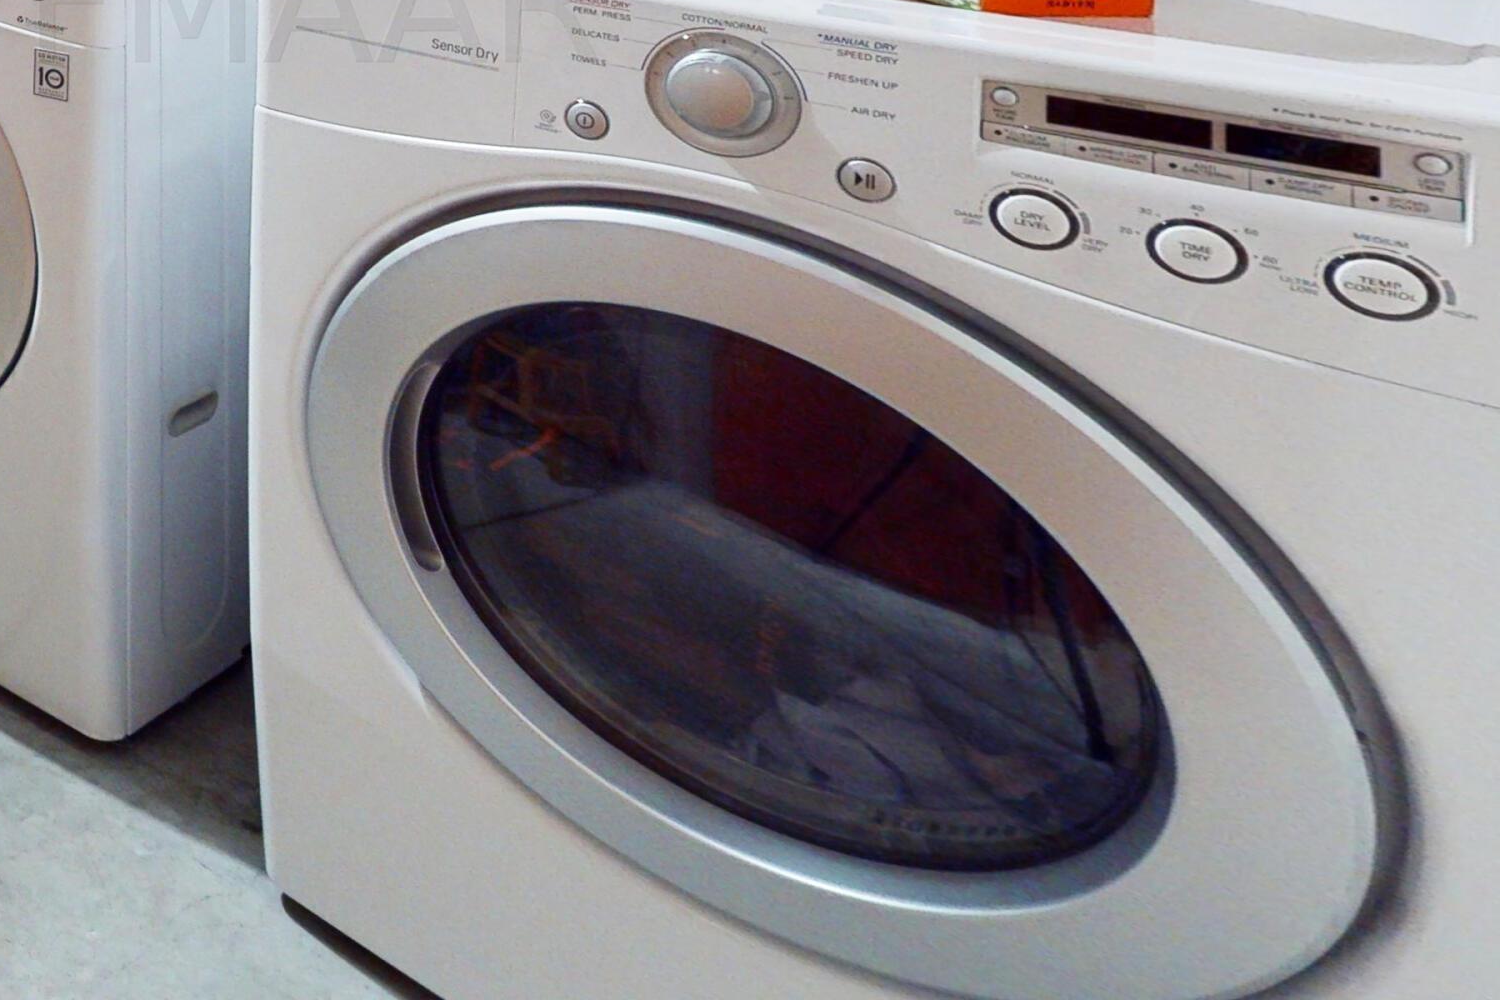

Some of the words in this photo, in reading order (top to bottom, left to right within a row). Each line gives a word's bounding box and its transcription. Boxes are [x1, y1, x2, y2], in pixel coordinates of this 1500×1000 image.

[611, 0, 630, 8] DRY
[602, 10, 631, 21] PRESS
[571, 27, 620, 42] DELICATES
[823, 34, 870, 48] MANUAL
[874, 41, 898, 51] DRY
[431, 38, 472, 57] Sensor
[475, 46, 499, 63] Dry
[836, 49, 873, 60] SPEED
[875, 55, 899, 65] DRY
[571, 53, 607, 67] TOWELS
[827, 71, 879, 88] FRESHEN
[882, 81, 899, 90] UP
[851, 106, 870, 116] AIR
[872, 110, 896, 120] DRY
[1020, 210, 1045, 221] DRY
[1014, 218, 1051, 231] LEVEL
[1181, 241, 1212, 254] TIME
[1182, 251, 1212, 262] DRY
[1358, 275, 1403, 290] TEMP
[1343, 282, 1418, 303] CONTROL
